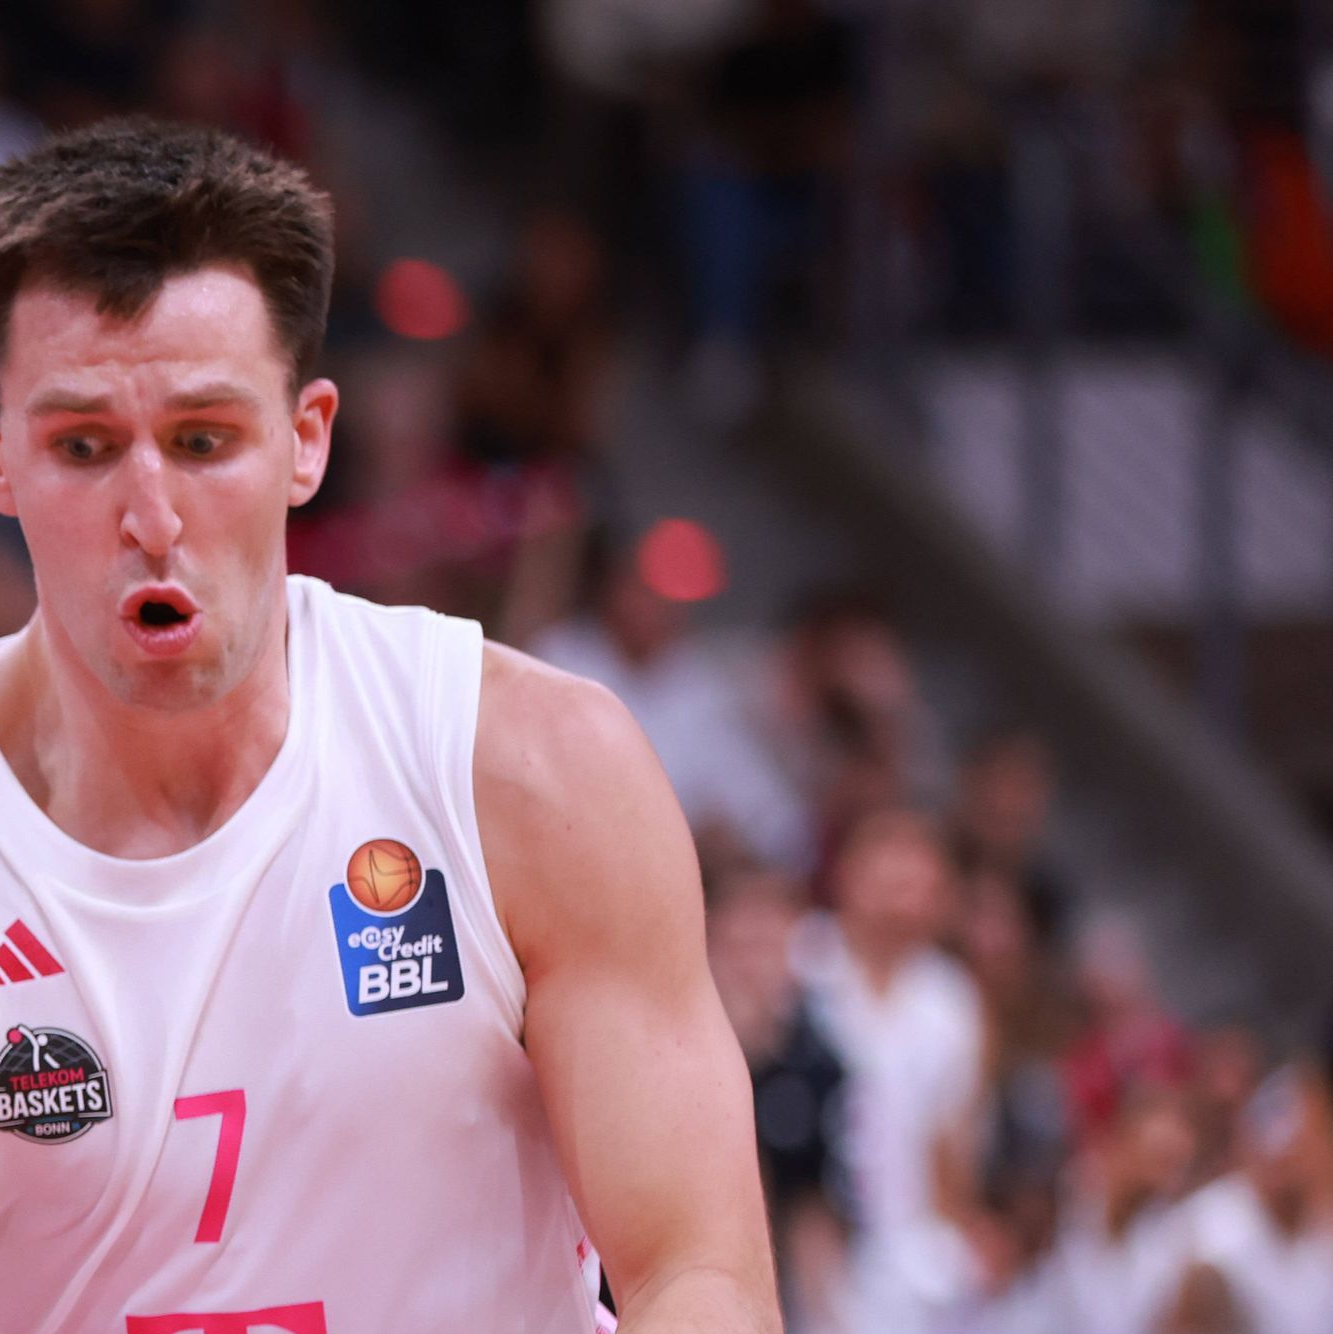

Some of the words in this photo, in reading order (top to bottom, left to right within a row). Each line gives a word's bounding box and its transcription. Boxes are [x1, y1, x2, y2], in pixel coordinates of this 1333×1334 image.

[377, 934, 443, 962] Credit
[358, 955, 449, 1005] BBL
[9, 1066, 85, 1092] TELEKOM
[34, 1121, 71, 1136] BONN
[174, 1088, 247, 1244] 7
